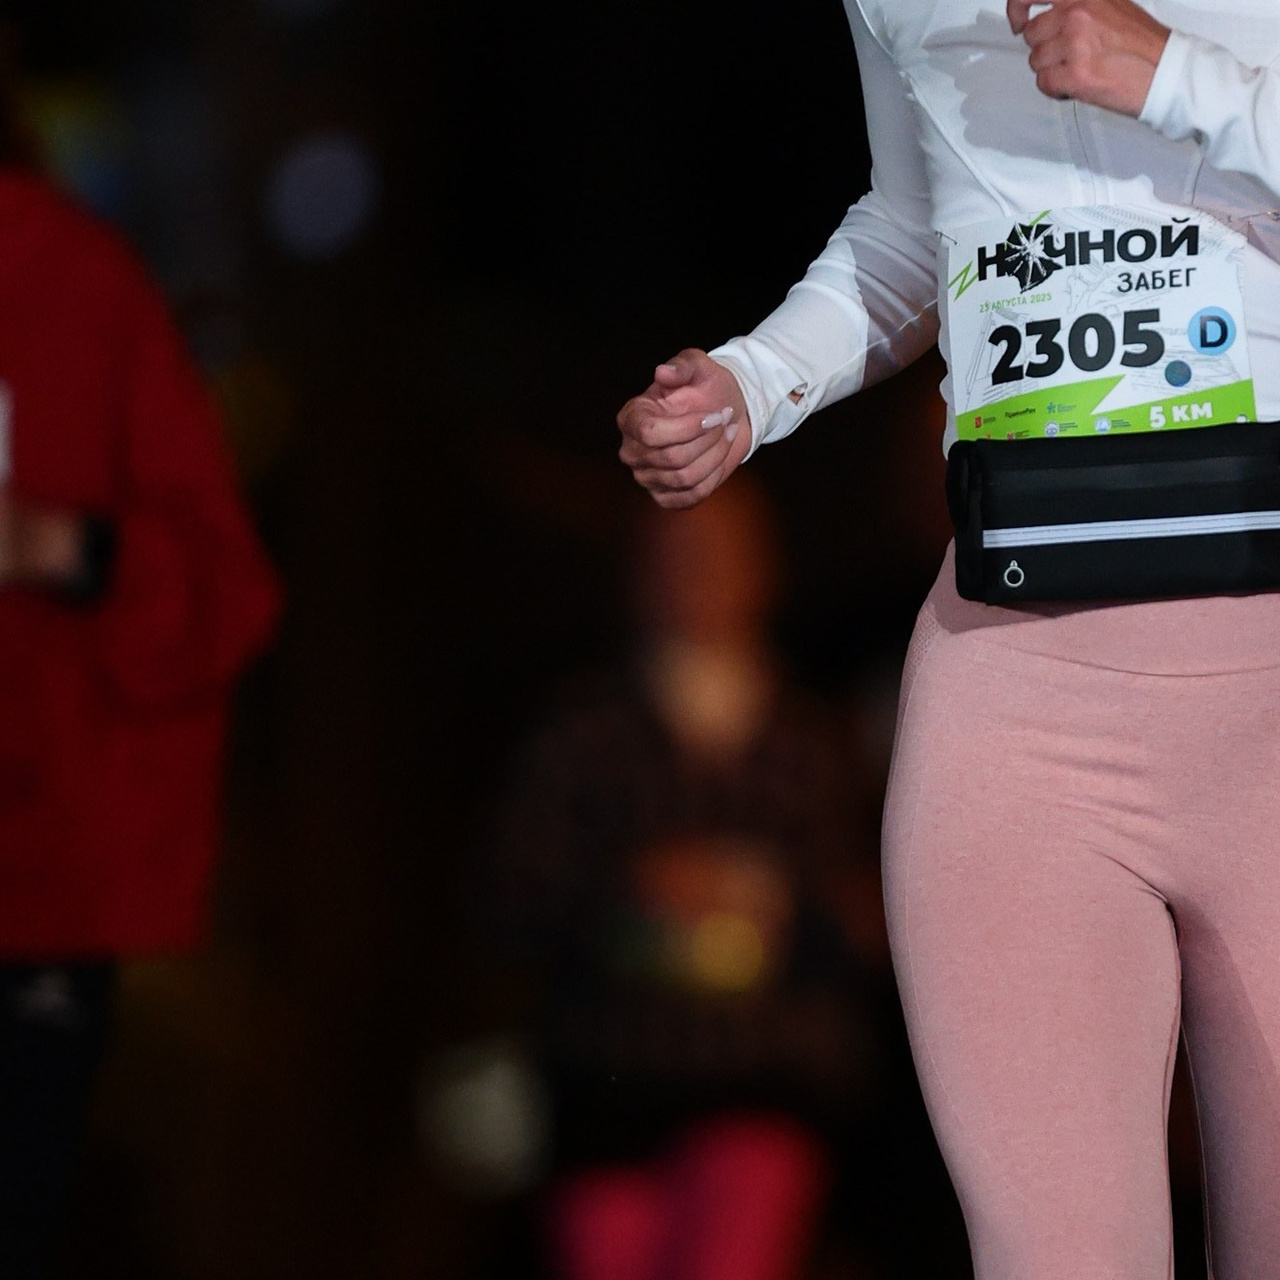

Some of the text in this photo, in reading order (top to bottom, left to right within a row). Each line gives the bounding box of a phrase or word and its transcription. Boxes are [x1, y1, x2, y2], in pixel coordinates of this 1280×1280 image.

[1116, 267, 1197, 293] ЗАБЕГ
[991, 295, 1027, 311] АВГУСТА
[1030, 292, 1052, 305] 2025
[1200, 315, 1228, 348] D
[988, 308, 1165, 386] 2305
[1150, 401, 1213, 429] 5 КМ
